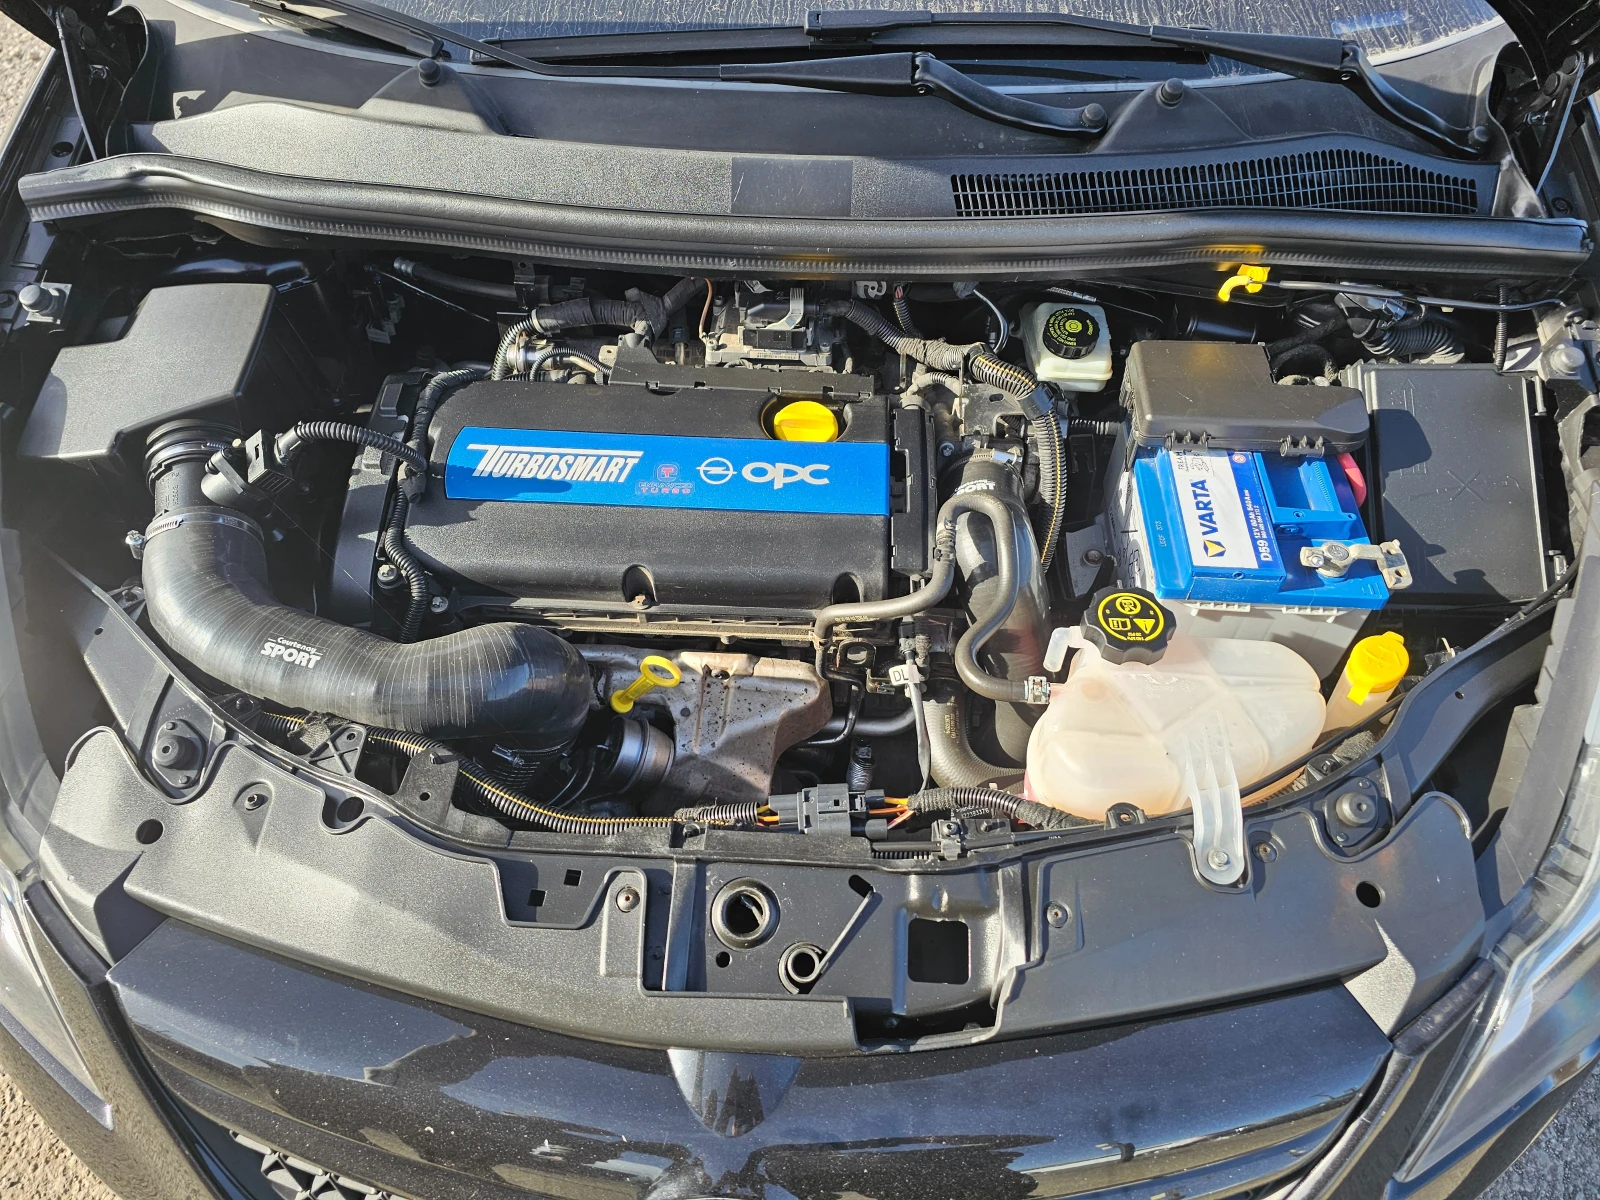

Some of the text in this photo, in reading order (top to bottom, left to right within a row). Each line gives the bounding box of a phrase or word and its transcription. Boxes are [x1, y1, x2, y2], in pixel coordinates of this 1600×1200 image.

[467, 443, 644, 483] TURBOSMART
[1190, 479, 1219, 536] VARTA
[1256, 539, 1273, 561] D59
[260, 641, 321, 669] SPORT
[277, 637, 317, 655] Courtenay
[892, 668, 909, 682] DL
